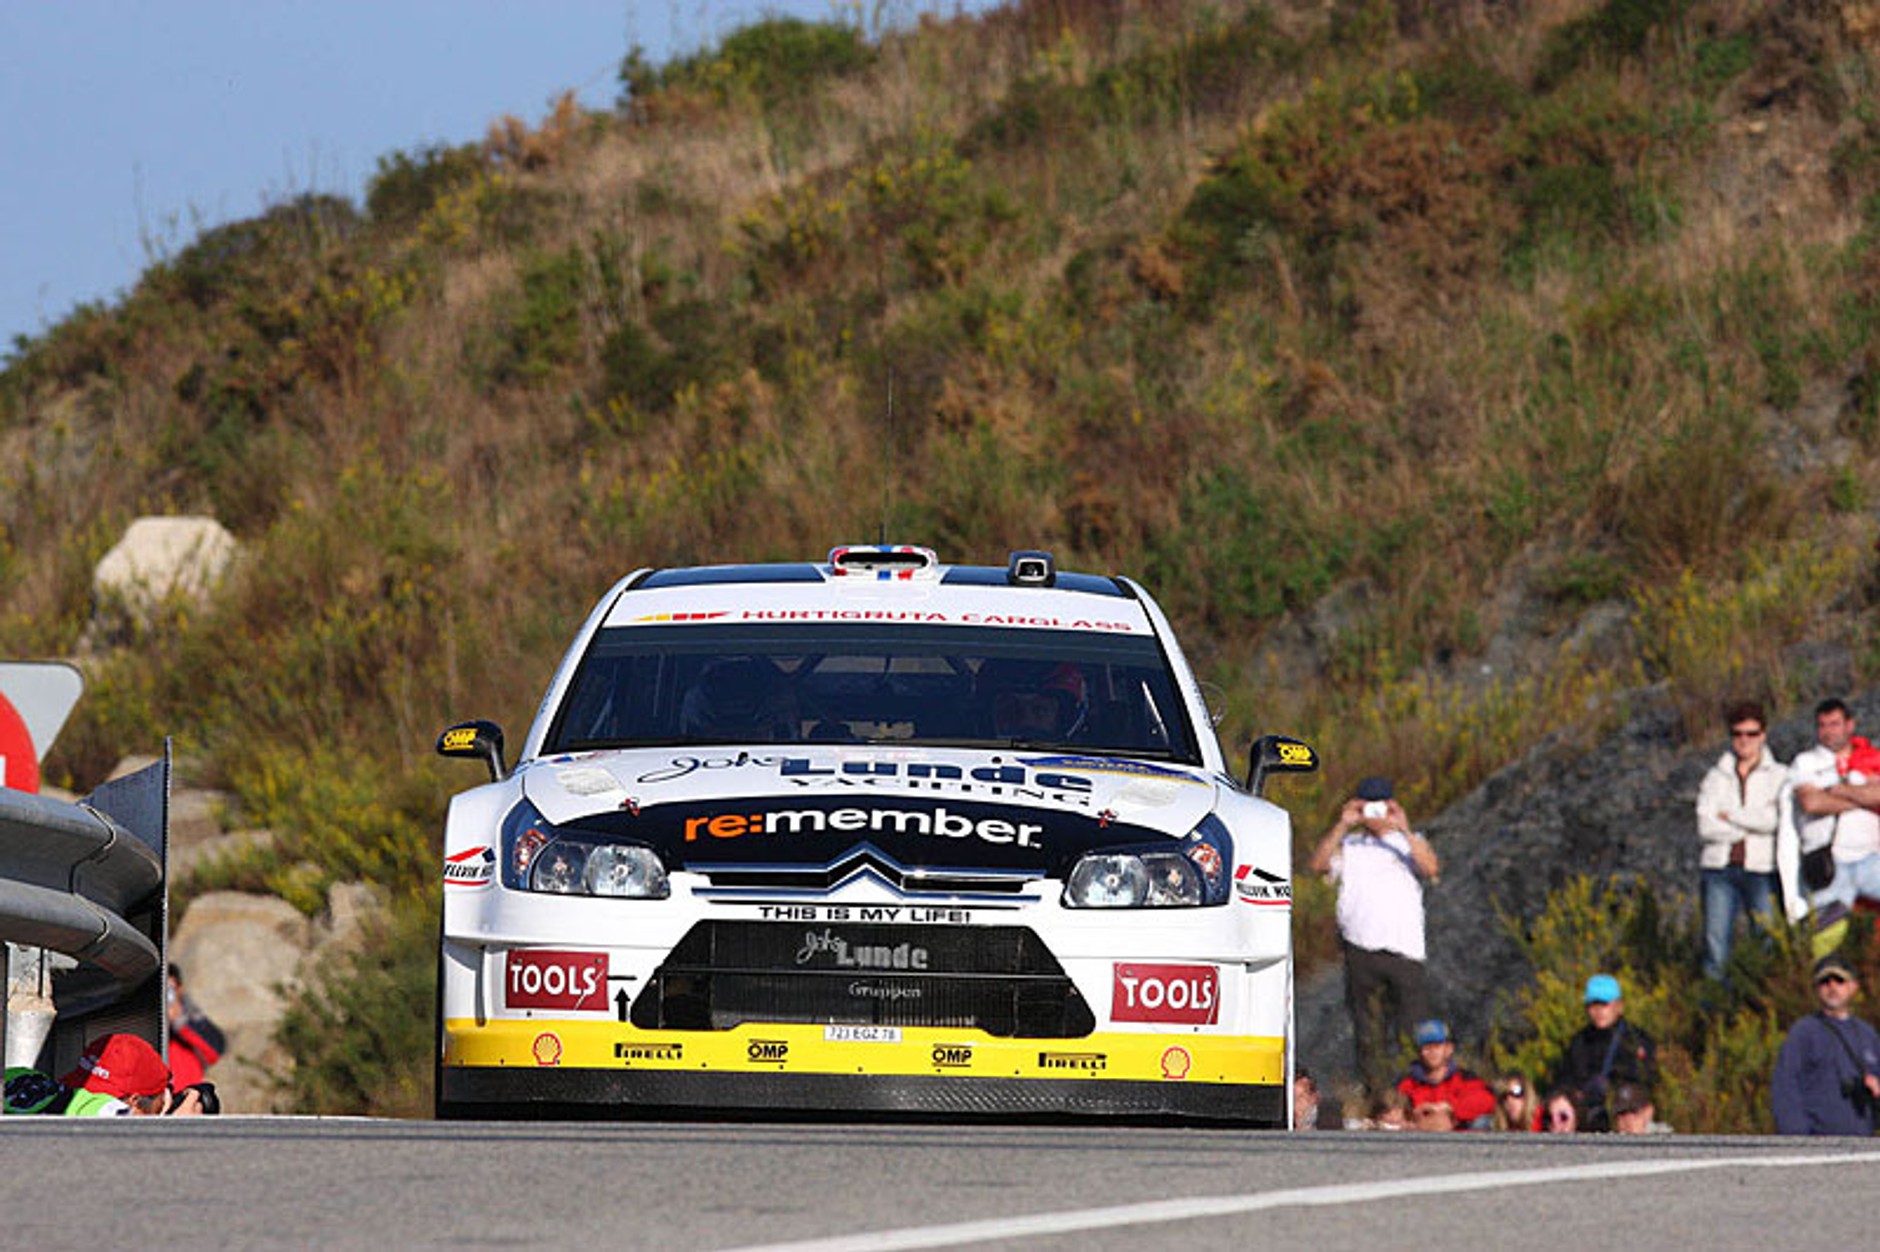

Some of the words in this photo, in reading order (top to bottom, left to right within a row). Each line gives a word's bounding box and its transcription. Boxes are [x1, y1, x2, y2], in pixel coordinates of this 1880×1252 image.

[742, 610, 947, 622] HURTIGRUTA
[961, 613, 1132, 632] CARGLASS
[444, 729, 477, 747] OMP
[1277, 743, 1312, 760] OMP
[780, 756, 1093, 792] Lunde
[759, 906, 817, 920] THIS
[827, 907, 851, 920] IS
[860, 908, 902, 922] MY
[910, 910, 972, 924] LIFE!
[837, 940, 929, 970] Lunde
[510, 964, 598, 995] TOOLS
[849, 980, 922, 1000] Gruppen
[1121, 976, 1214, 1010] TOOLS
[614, 1043, 683, 1060] PIRELLI
[747, 1043, 789, 1059] OMP
[932, 1049, 973, 1064] OMP
[1038, 1052, 1107, 1070] PIRELLI
